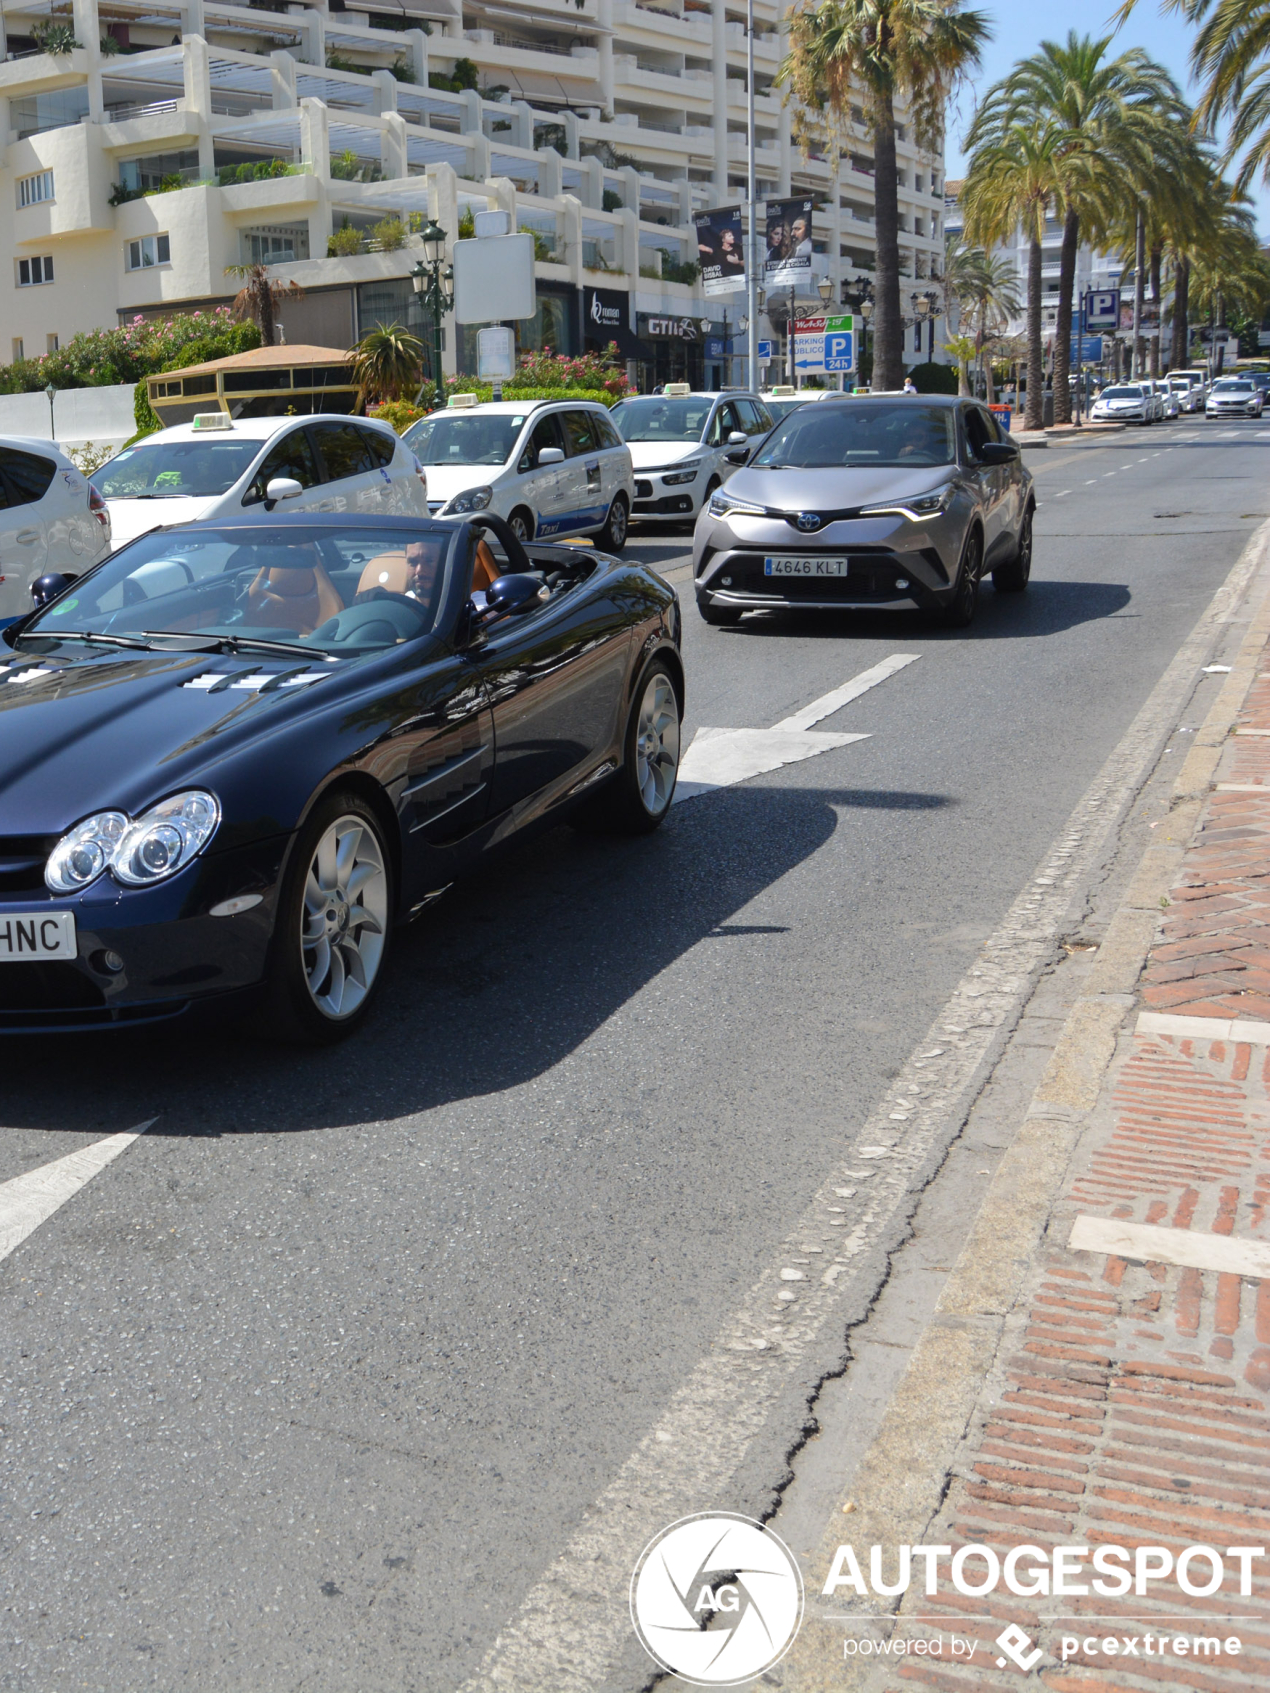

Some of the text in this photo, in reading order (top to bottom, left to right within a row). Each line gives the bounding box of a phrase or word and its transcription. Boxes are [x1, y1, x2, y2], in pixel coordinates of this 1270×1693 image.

[703, 264, 721, 273] DAVID
[1092, 294, 1113, 315] P
[831, 338, 846, 357] P
[540, 522, 560, 535] Taxi
[775, 561, 844, 574] 4646 KLT
